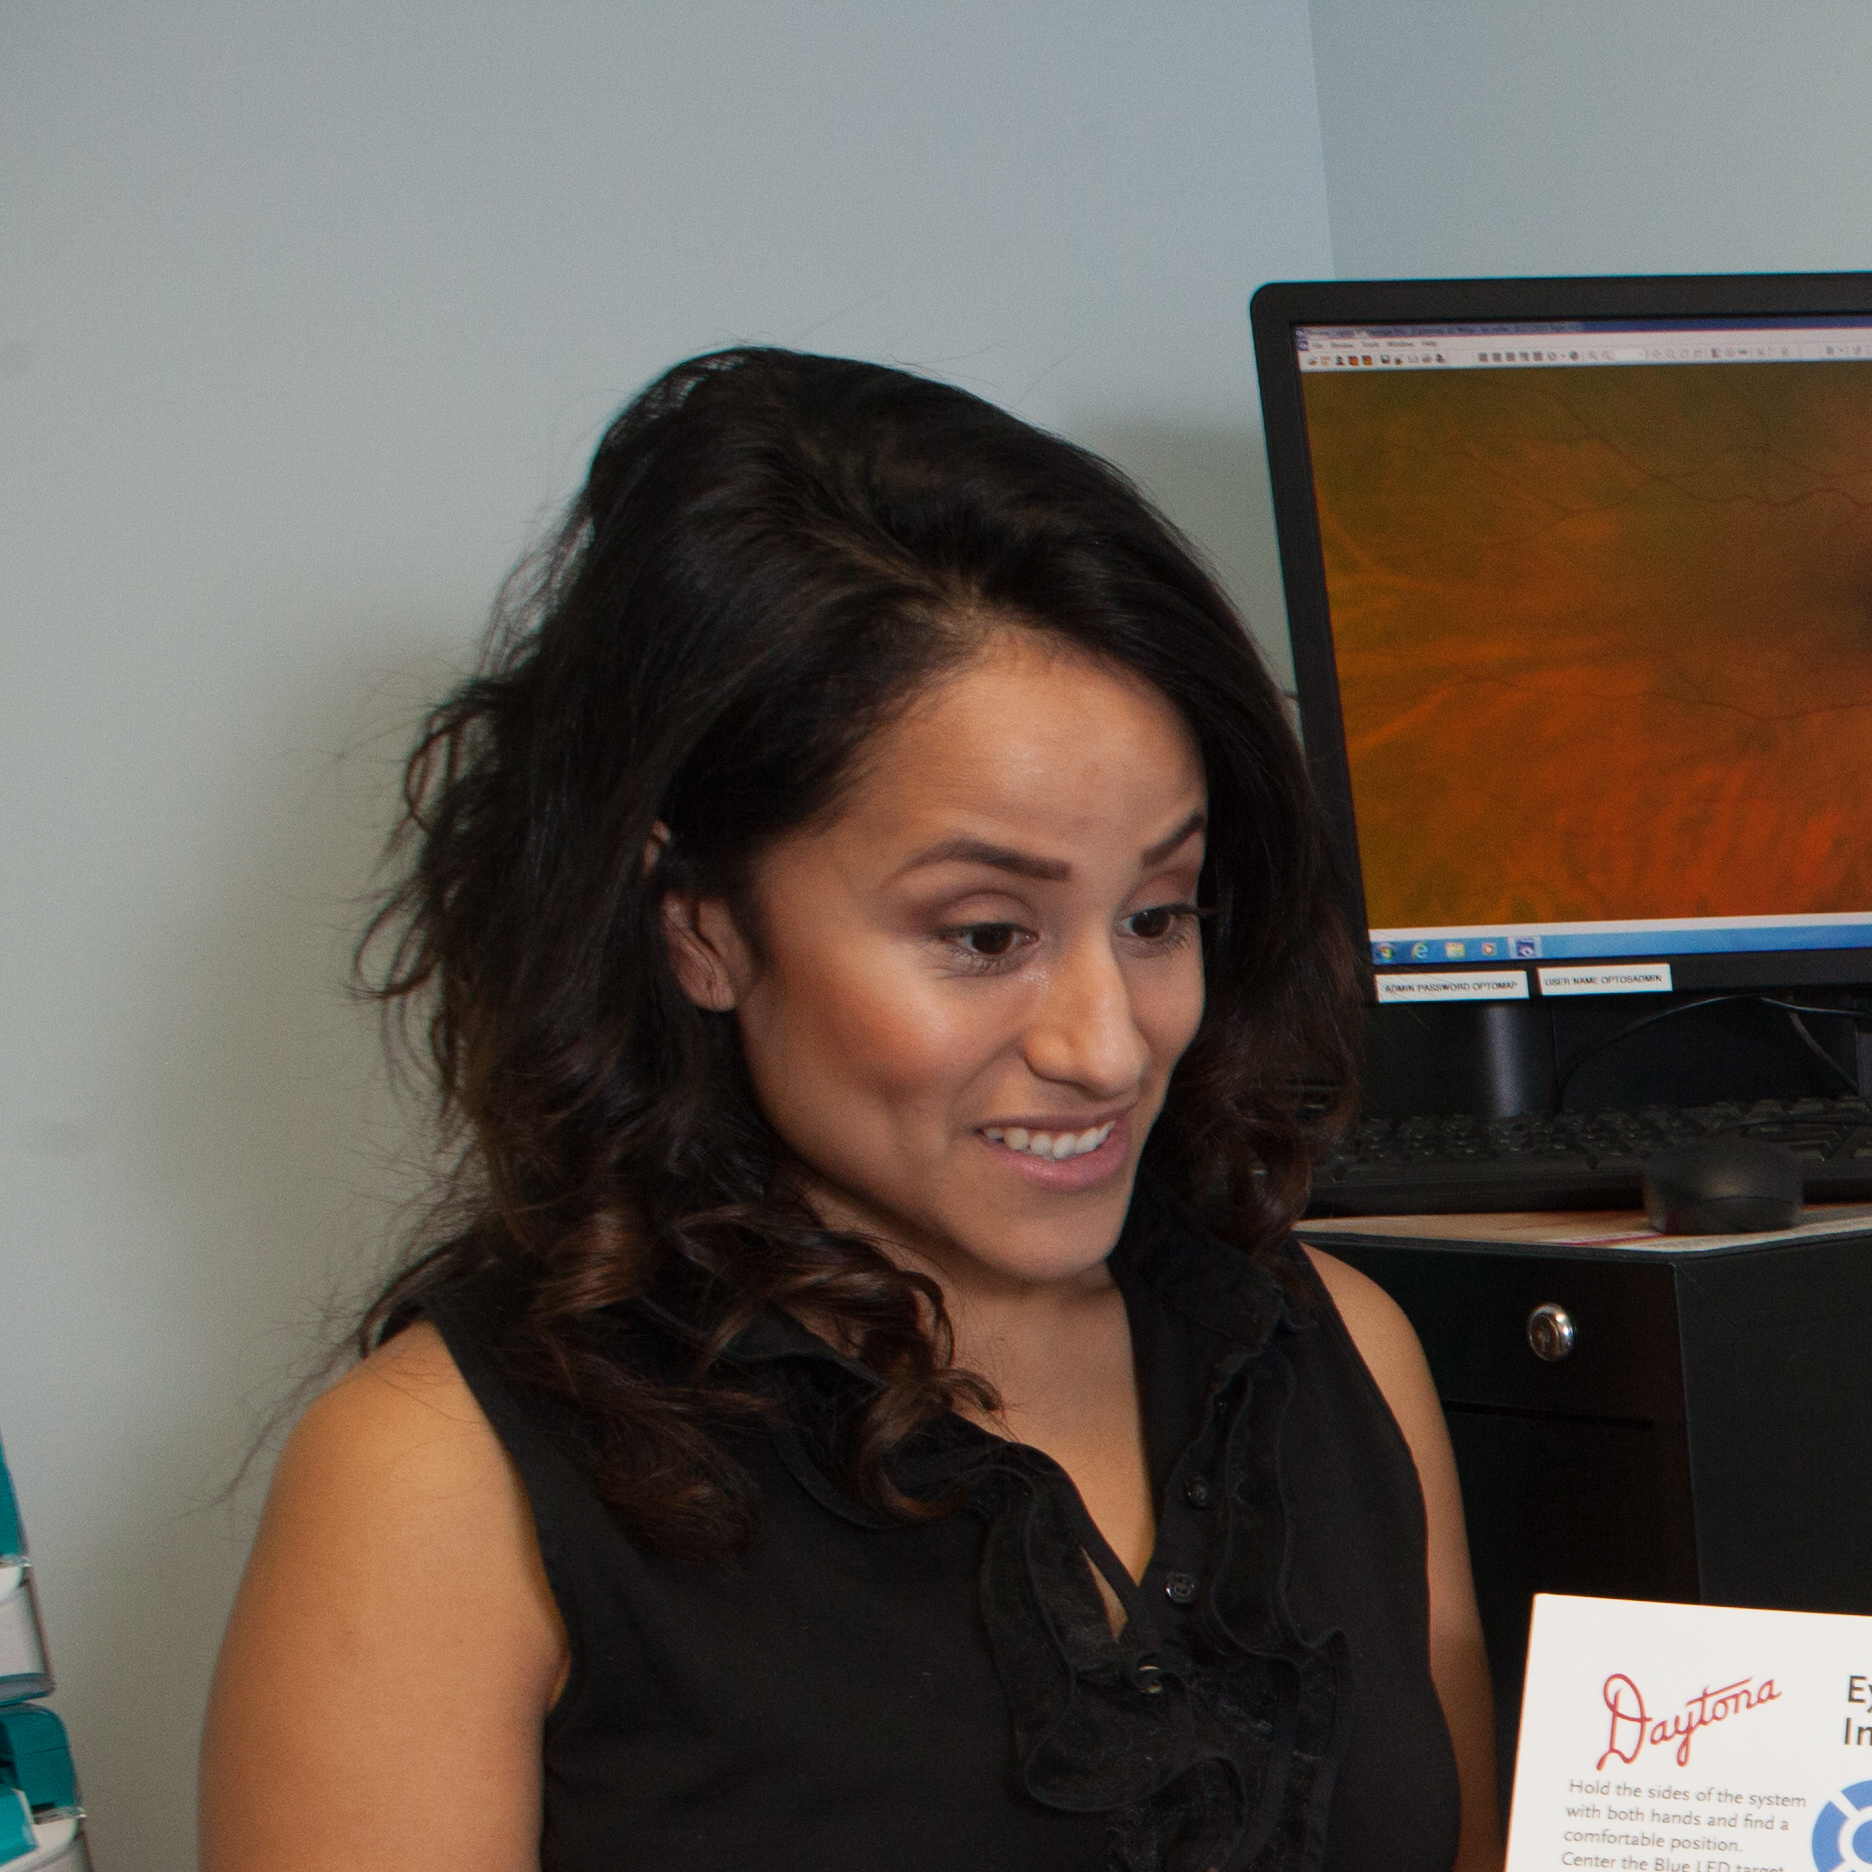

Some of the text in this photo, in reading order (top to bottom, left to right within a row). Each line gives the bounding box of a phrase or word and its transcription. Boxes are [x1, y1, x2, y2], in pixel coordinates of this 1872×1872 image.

[1385, 982, 1518, 992] ADMIN PASSWORD OPTOMAP
[1545, 978, 1570, 987] USER
[1572, 977, 1599, 986] NAME
[1596, 1673, 1783, 1771] Daytona
[1569, 1780, 1807, 1809] Hold the sides of the system
[1566, 1805, 1789, 1831] with both hands and find a
[1564, 1829, 1743, 1852] comfortable position.
[1562, 1852, 1617, 1868] Center
[1622, 1856, 1648, 1870] the
[1654, 1858, 1690, 1872] Blue
